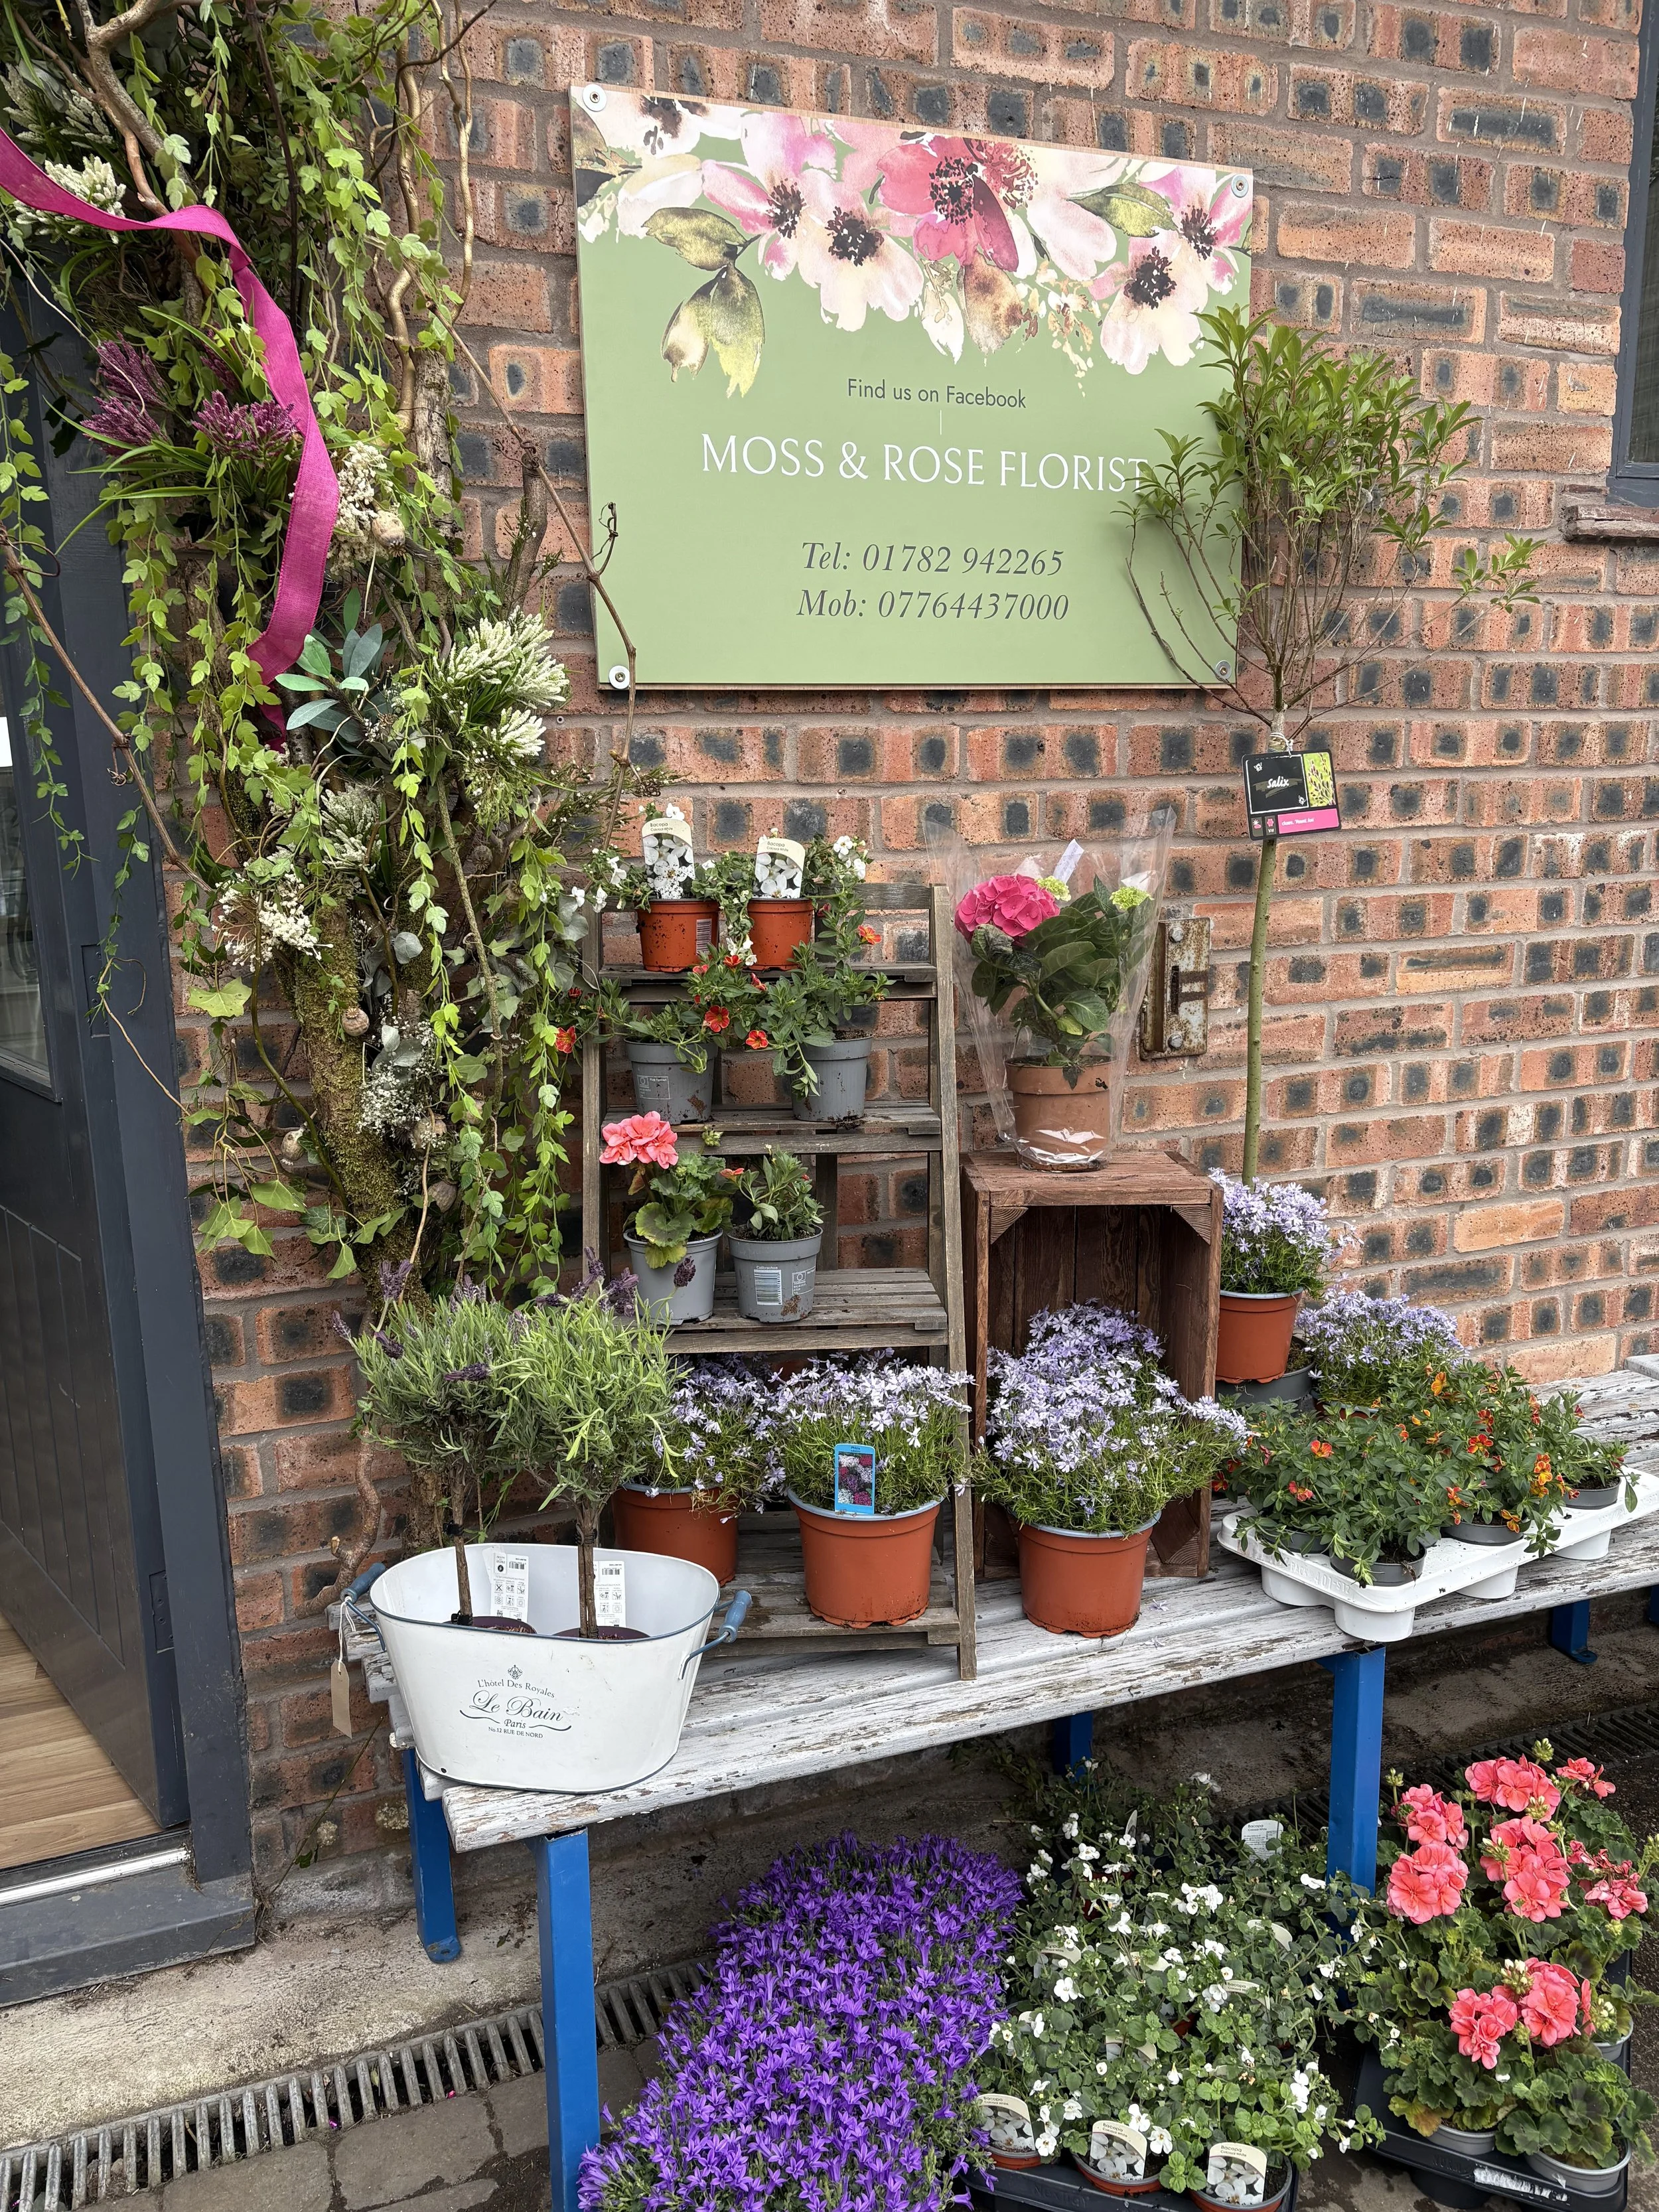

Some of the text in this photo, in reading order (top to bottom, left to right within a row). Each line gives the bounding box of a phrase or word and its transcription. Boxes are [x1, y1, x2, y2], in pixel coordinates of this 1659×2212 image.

[848, 378, 1027, 409] Find us on Facebook
[701, 433, 1148, 492] MOSS & ROSE FLORIST
[802, 542, 1064, 576] Tel: 01782 942265
[796, 589, 1069, 621] Mob: 07764437000
[1267, 775, 1289, 788] Salix
[507, 1678, 523, 1689] Des
[524, 1682, 555, 1699] Royales
[469, 1690, 563, 1721] Le Bain
[504, 1719, 526, 1729] Paris
[1103, 2122, 1123, 2132] Bacopa
